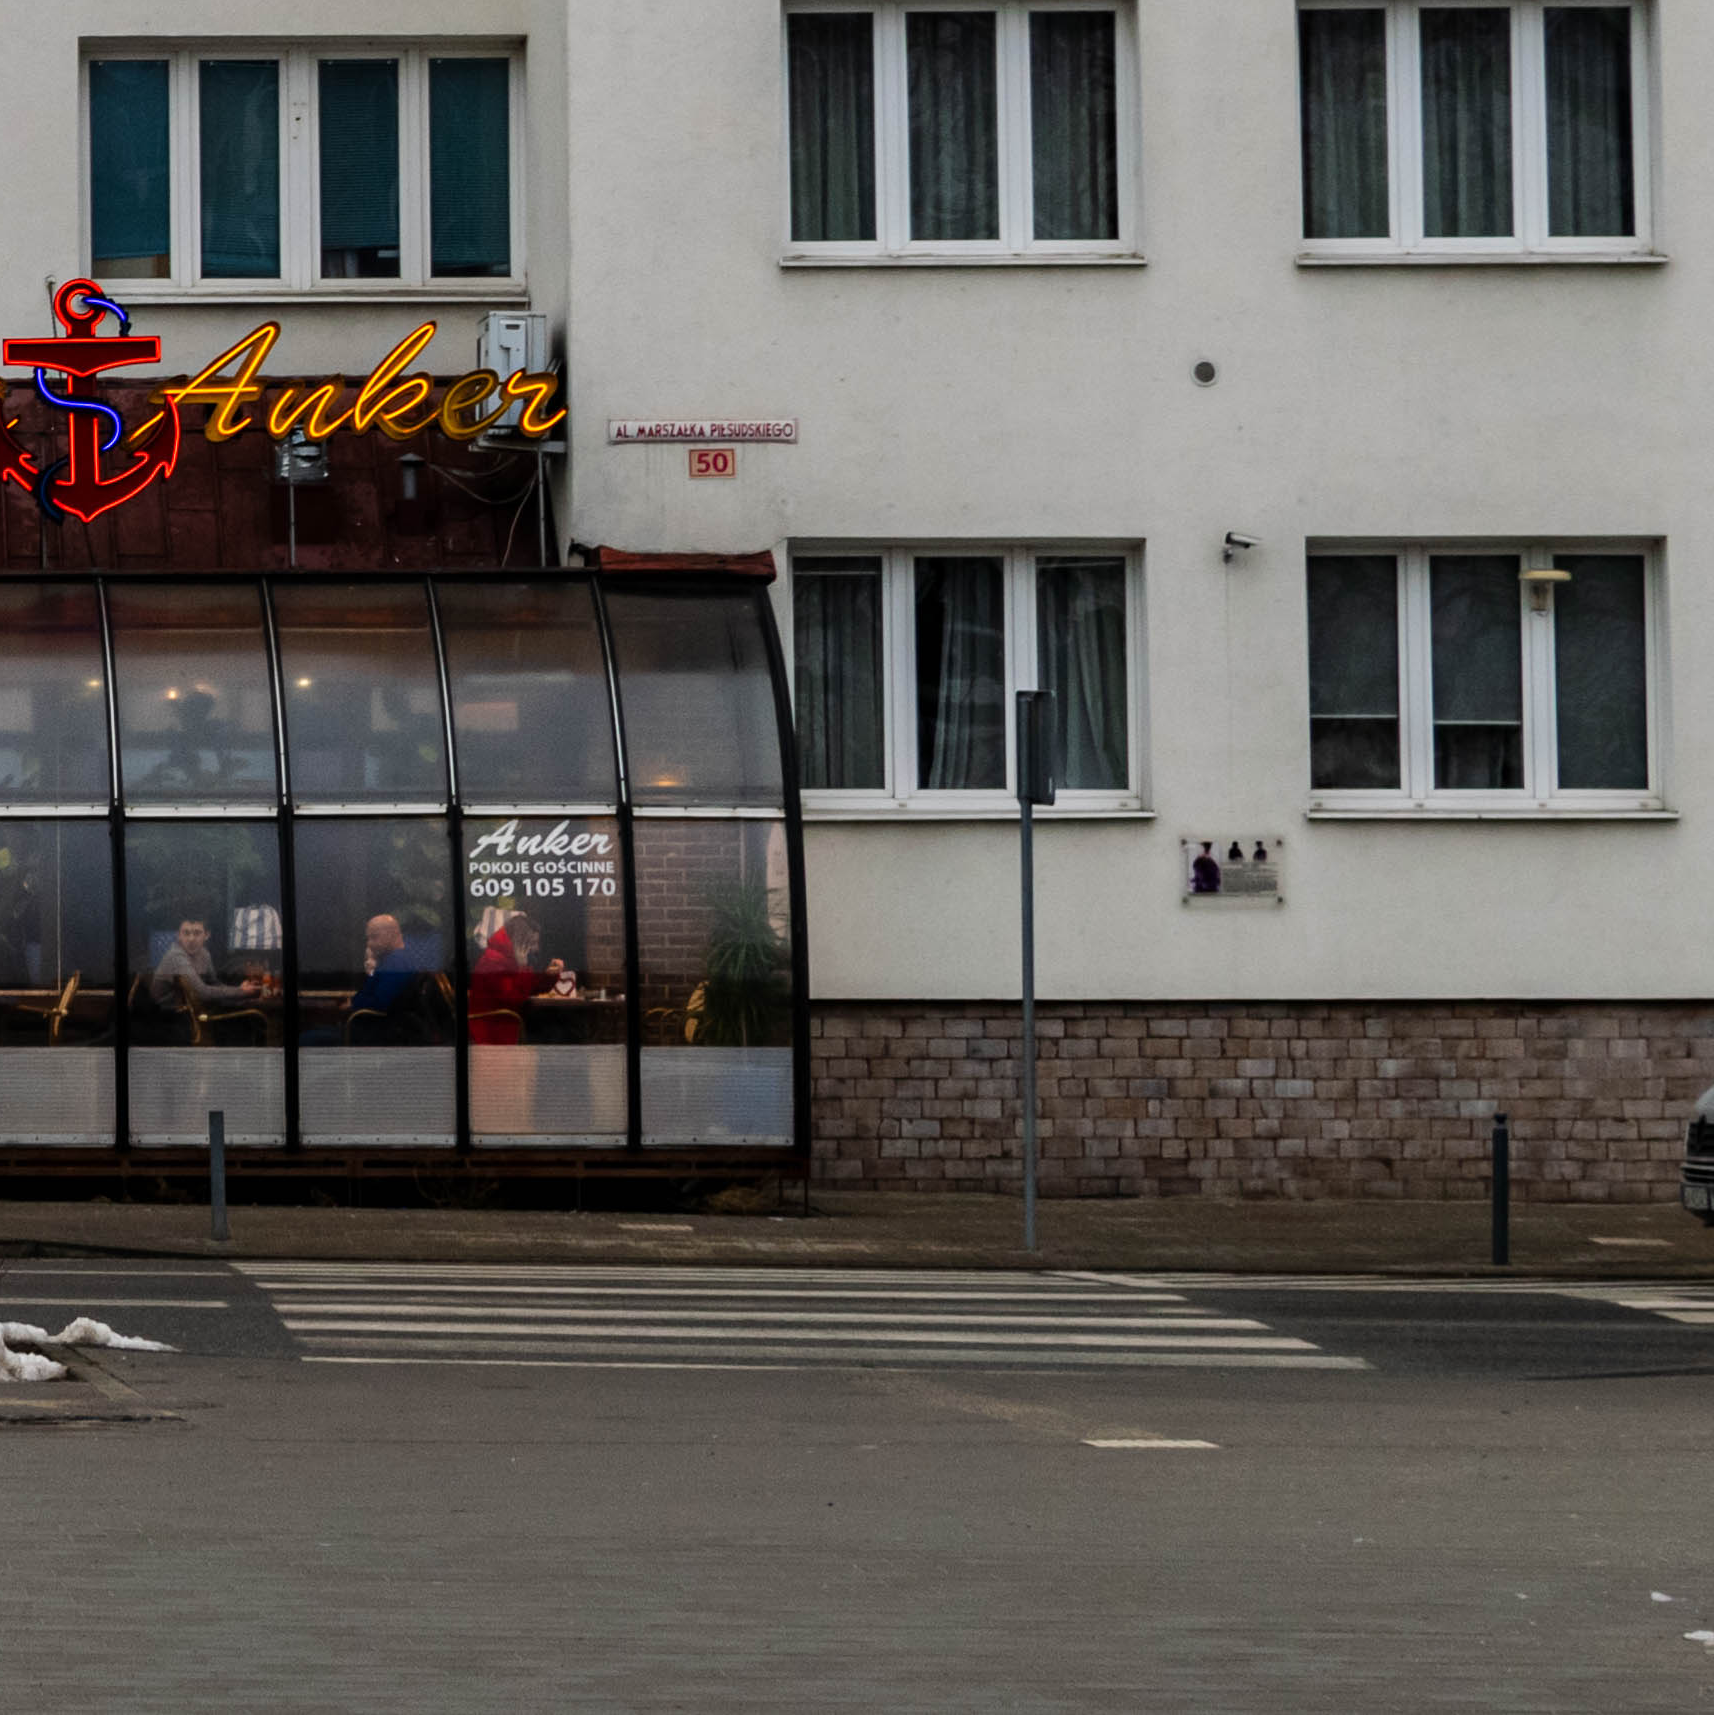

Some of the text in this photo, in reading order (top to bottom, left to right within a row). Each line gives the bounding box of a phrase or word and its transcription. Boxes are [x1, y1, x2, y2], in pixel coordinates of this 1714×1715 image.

[129, 320, 568, 446] Anker
[636, 422, 705, 438] MARSZAŁKA
[710, 422, 794, 438] PIŁSUDSKIEGO
[696, 452, 729, 473] 50
[469, 818, 613, 858] Anker
[469, 858, 614, 875] POKOJE GOŚCINNE
[470, 878, 616, 897] 609 105 170
